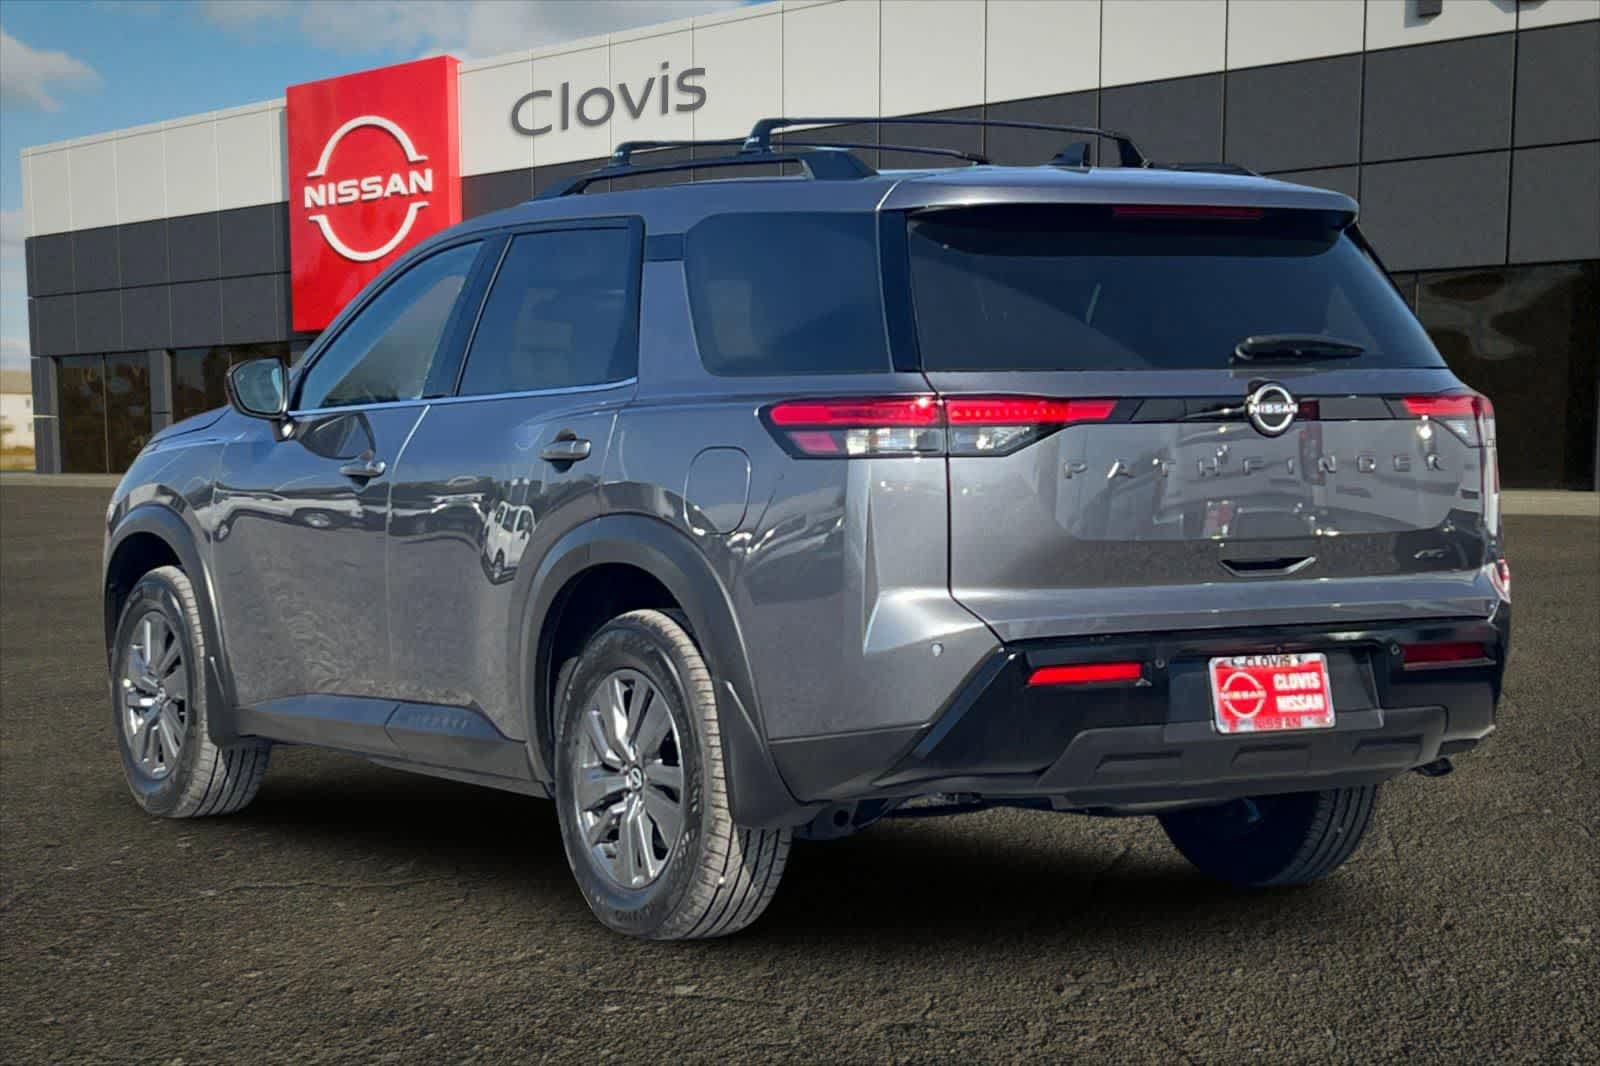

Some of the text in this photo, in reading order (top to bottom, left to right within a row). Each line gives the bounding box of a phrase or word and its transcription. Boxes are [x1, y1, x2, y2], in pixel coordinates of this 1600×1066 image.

[510, 61, 707, 137] Clovis
[303, 168, 433, 208] NISSAN
[1248, 403, 1298, 415] NISSAN
[1063, 452, 1446, 480] PATHFINDER
[1273, 671, 1321, 690] CLOVIS
[1276, 693, 1325, 713] NISSAN
